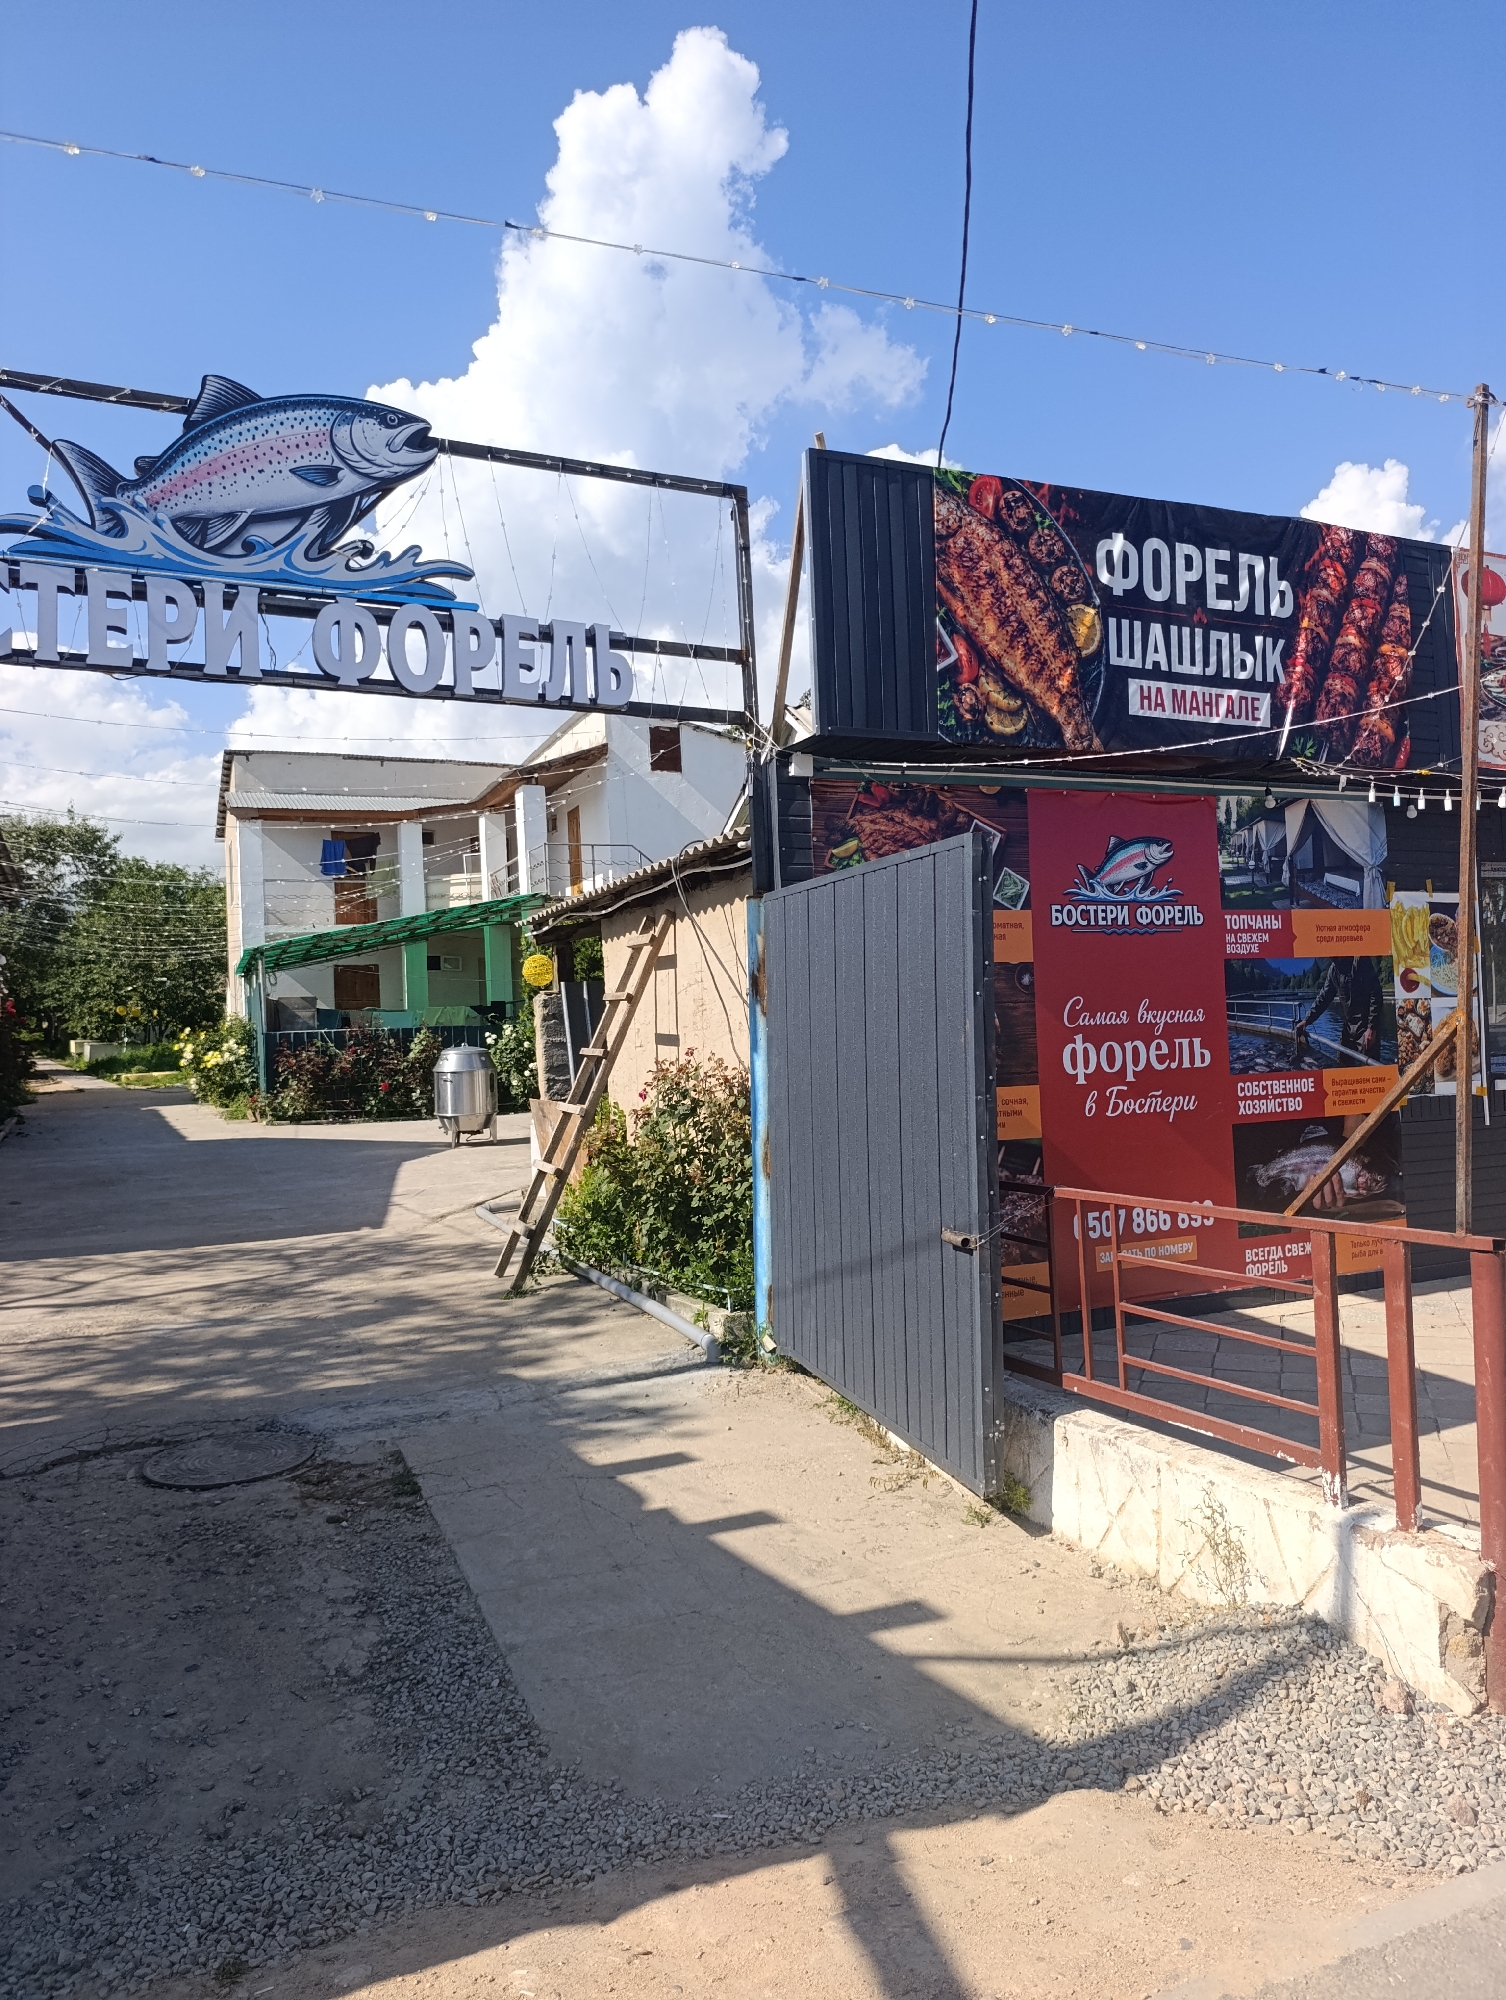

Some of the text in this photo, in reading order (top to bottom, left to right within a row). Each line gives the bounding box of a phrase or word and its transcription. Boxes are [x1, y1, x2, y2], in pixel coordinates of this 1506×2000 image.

[1096, 532, 1294, 618] ФОРЕЛЬ
[312, 598, 635, 709] ФОРЕЛЬ
[1108, 617, 1286, 684] ШАШЛЫК
[1139, 685, 1261, 721] НА МАНГАЛЕ
[1051, 904, 1204, 926] БОСТЕРИ ФОРЕЛЬ
[1225, 914, 1282, 930] ТОПЧАНЫ
[993, 922, 1024, 930] оматная,
[1315, 924, 1371, 933] Уютная атмосфера
[1225, 932, 1269, 943] НА СВЕЖЕМ
[1316, 935, 1364, 944] среди деревьев
[1226, 943, 1259, 955] ВОЗДУХЕ
[1063, 996, 1206, 1035] Самая вкусная
[1062, 1034, 1211, 1084] форель
[1237, 1077, 1315, 1097] СОБСТВЕННОЕ
[1331, 1077, 1371, 1087] Выращиваем
[1371, 1076, 1386, 1084] сами
[1331, 1086, 1386, 1098] гарантия качества
[1085, 1085, 1198, 1122] в Бостери
[1238, 1096, 1303, 1115] ХОЗЯЙСТВО
[1337, 1098, 1366, 1106] свежести
[997, 1109, 1023, 1117] тными
[1132, 1206, 1172, 1234] 866
[1144, 1246, 1157, 1258] ПО
[1158, 1241, 1194, 1257] НОМЕРУ
[1245, 1240, 1312, 1263] ВСЕГДА СВЕЖ
[1351, 1250, 1366, 1260] рыба
[1368, 1249, 1379, 1257] для
[1245, 1259, 1289, 1277] ФОРЕЛЬ
